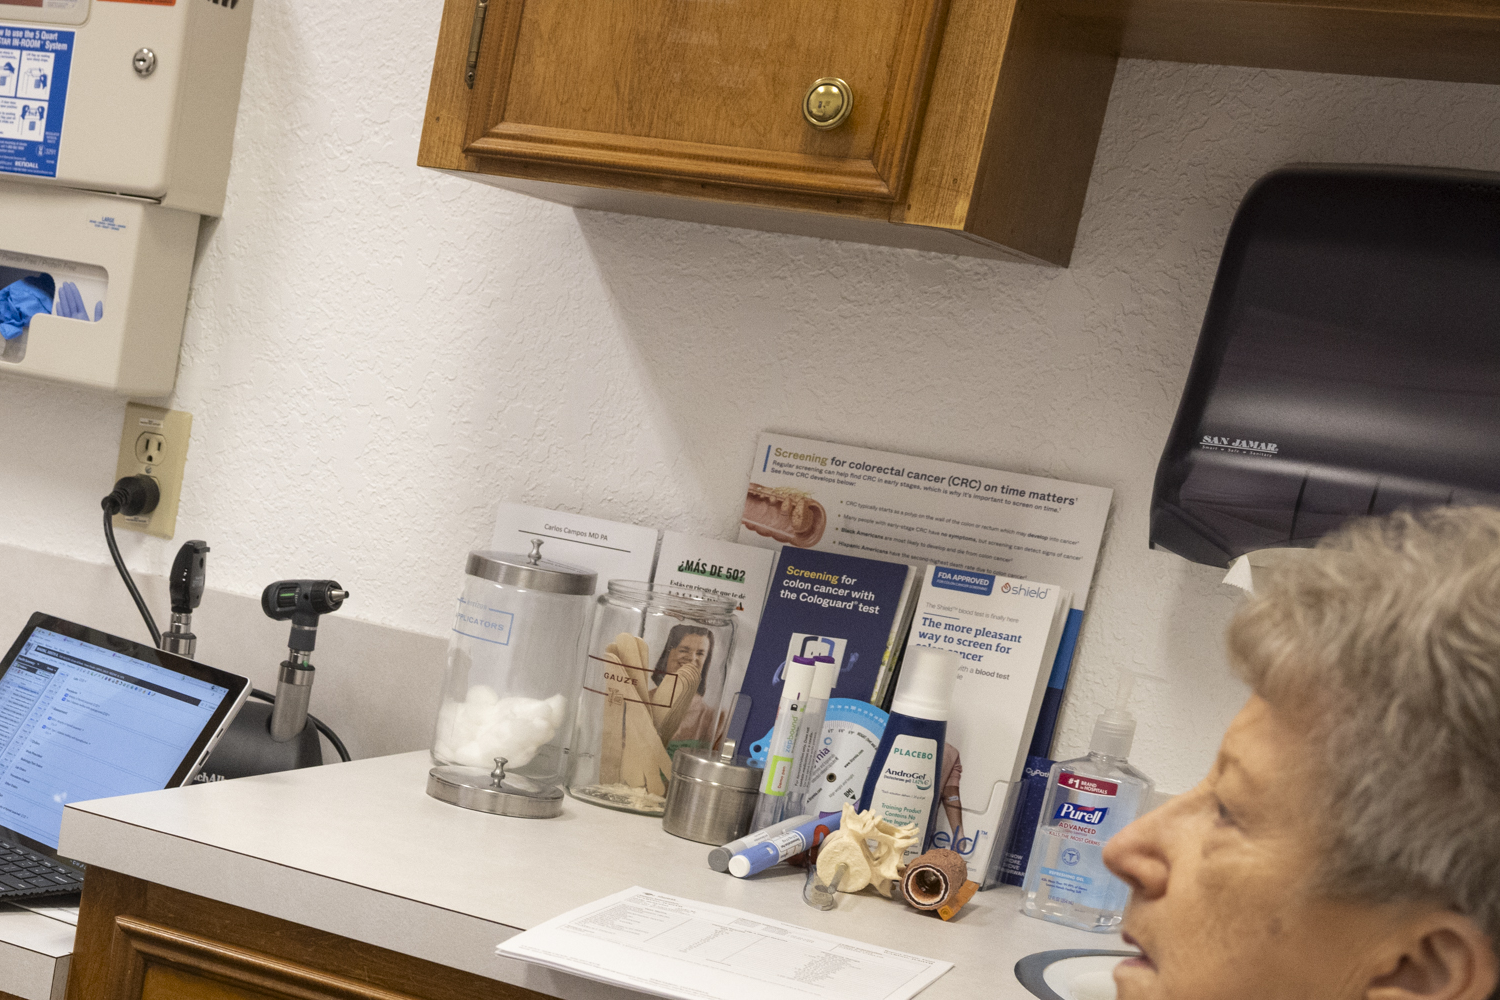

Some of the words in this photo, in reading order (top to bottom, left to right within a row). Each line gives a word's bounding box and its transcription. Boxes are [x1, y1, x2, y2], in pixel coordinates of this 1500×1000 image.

[5, 28, 11, 37] to
[24, 30, 34, 38] the
[35, 31, 40, 39] 5
[41, 31, 58, 41] Quart
[45, 41, 68, 51] System
[1202, 435, 1230, 445] SAN
[774, 447, 828, 466] Screening
[830, 456, 847, 467] for
[848, 461, 905, 477] colorectal
[907, 471, 946, 484] cancer
[948, 475, 982, 491] (CRC)
[983, 483, 998, 493] on
[1000, 484, 1026, 498] time
[795, 471, 809, 479] CRC
[810, 474, 835, 484] develops
[836, 478, 856, 487] below:
[772, 459, 795, 469] Regular
[795, 464, 824, 475] screening
[836, 470, 849, 478] help
[850, 472, 861, 480] find
[862, 474, 876, 482] CRC
[884, 479, 899, 487] early
[900, 481, 922, 490] stages,
[923, 485, 941, 493] which
[973, 493, 1004, 504] important
[1012, 501, 1033, 509] screen
[544, 523, 563, 533] Carlos
[563, 526, 587, 538] Campos
[588, 530, 599, 540] MD
[600, 533, 609, 541] PA
[678, 558, 707, 576] ¿MÁS
[710, 565, 723, 578] DE
[725, 567, 746, 582] 50?
[786, 565, 839, 584] Screening
[841, 574, 857, 585] for
[937, 571, 951, 580] FDA
[952, 573, 990, 586] APPROVED
[669, 579, 685, 588] Estás
[694, 584, 711, 594] riesgo
[783, 579, 811, 590] colon
[813, 584, 850, 596] cancer
[851, 590, 875, 601] with
[780, 589, 797, 600] the
[858, 602, 880, 615] test
[926, 601, 936, 609] The
[958, 607, 973, 616] blood
[991, 612, 1007, 622] finally
[1007, 615, 1019, 624] here
[921, 616, 942, 629] The
[943, 622, 973, 634] more
[974, 626, 1022, 643] pleasant
[918, 631, 941, 644] way
[943, 634, 954, 644] to
[956, 638, 993, 651] screen
[995, 642, 1012, 655] for
[603, 672, 638, 686] GAUZE
[975, 668, 995, 678] blood
[996, 672, 1010, 681] test
[894, 747, 933, 760] PLACEBO
[885, 768, 927, 781] AndroGel
[1068, 778, 1080, 789] #1
[1084, 786, 1108, 795] HOSPITALS
[881, 803, 902, 813] Training
[903, 806, 922, 815] Product
[884, 810, 907, 820] Contains
[908, 813, 916, 821] No
[1060, 803, 1103, 824] Purell
[1058, 821, 1096, 835] ADVANCED
[1084, 838, 1101, 846] GERMS
